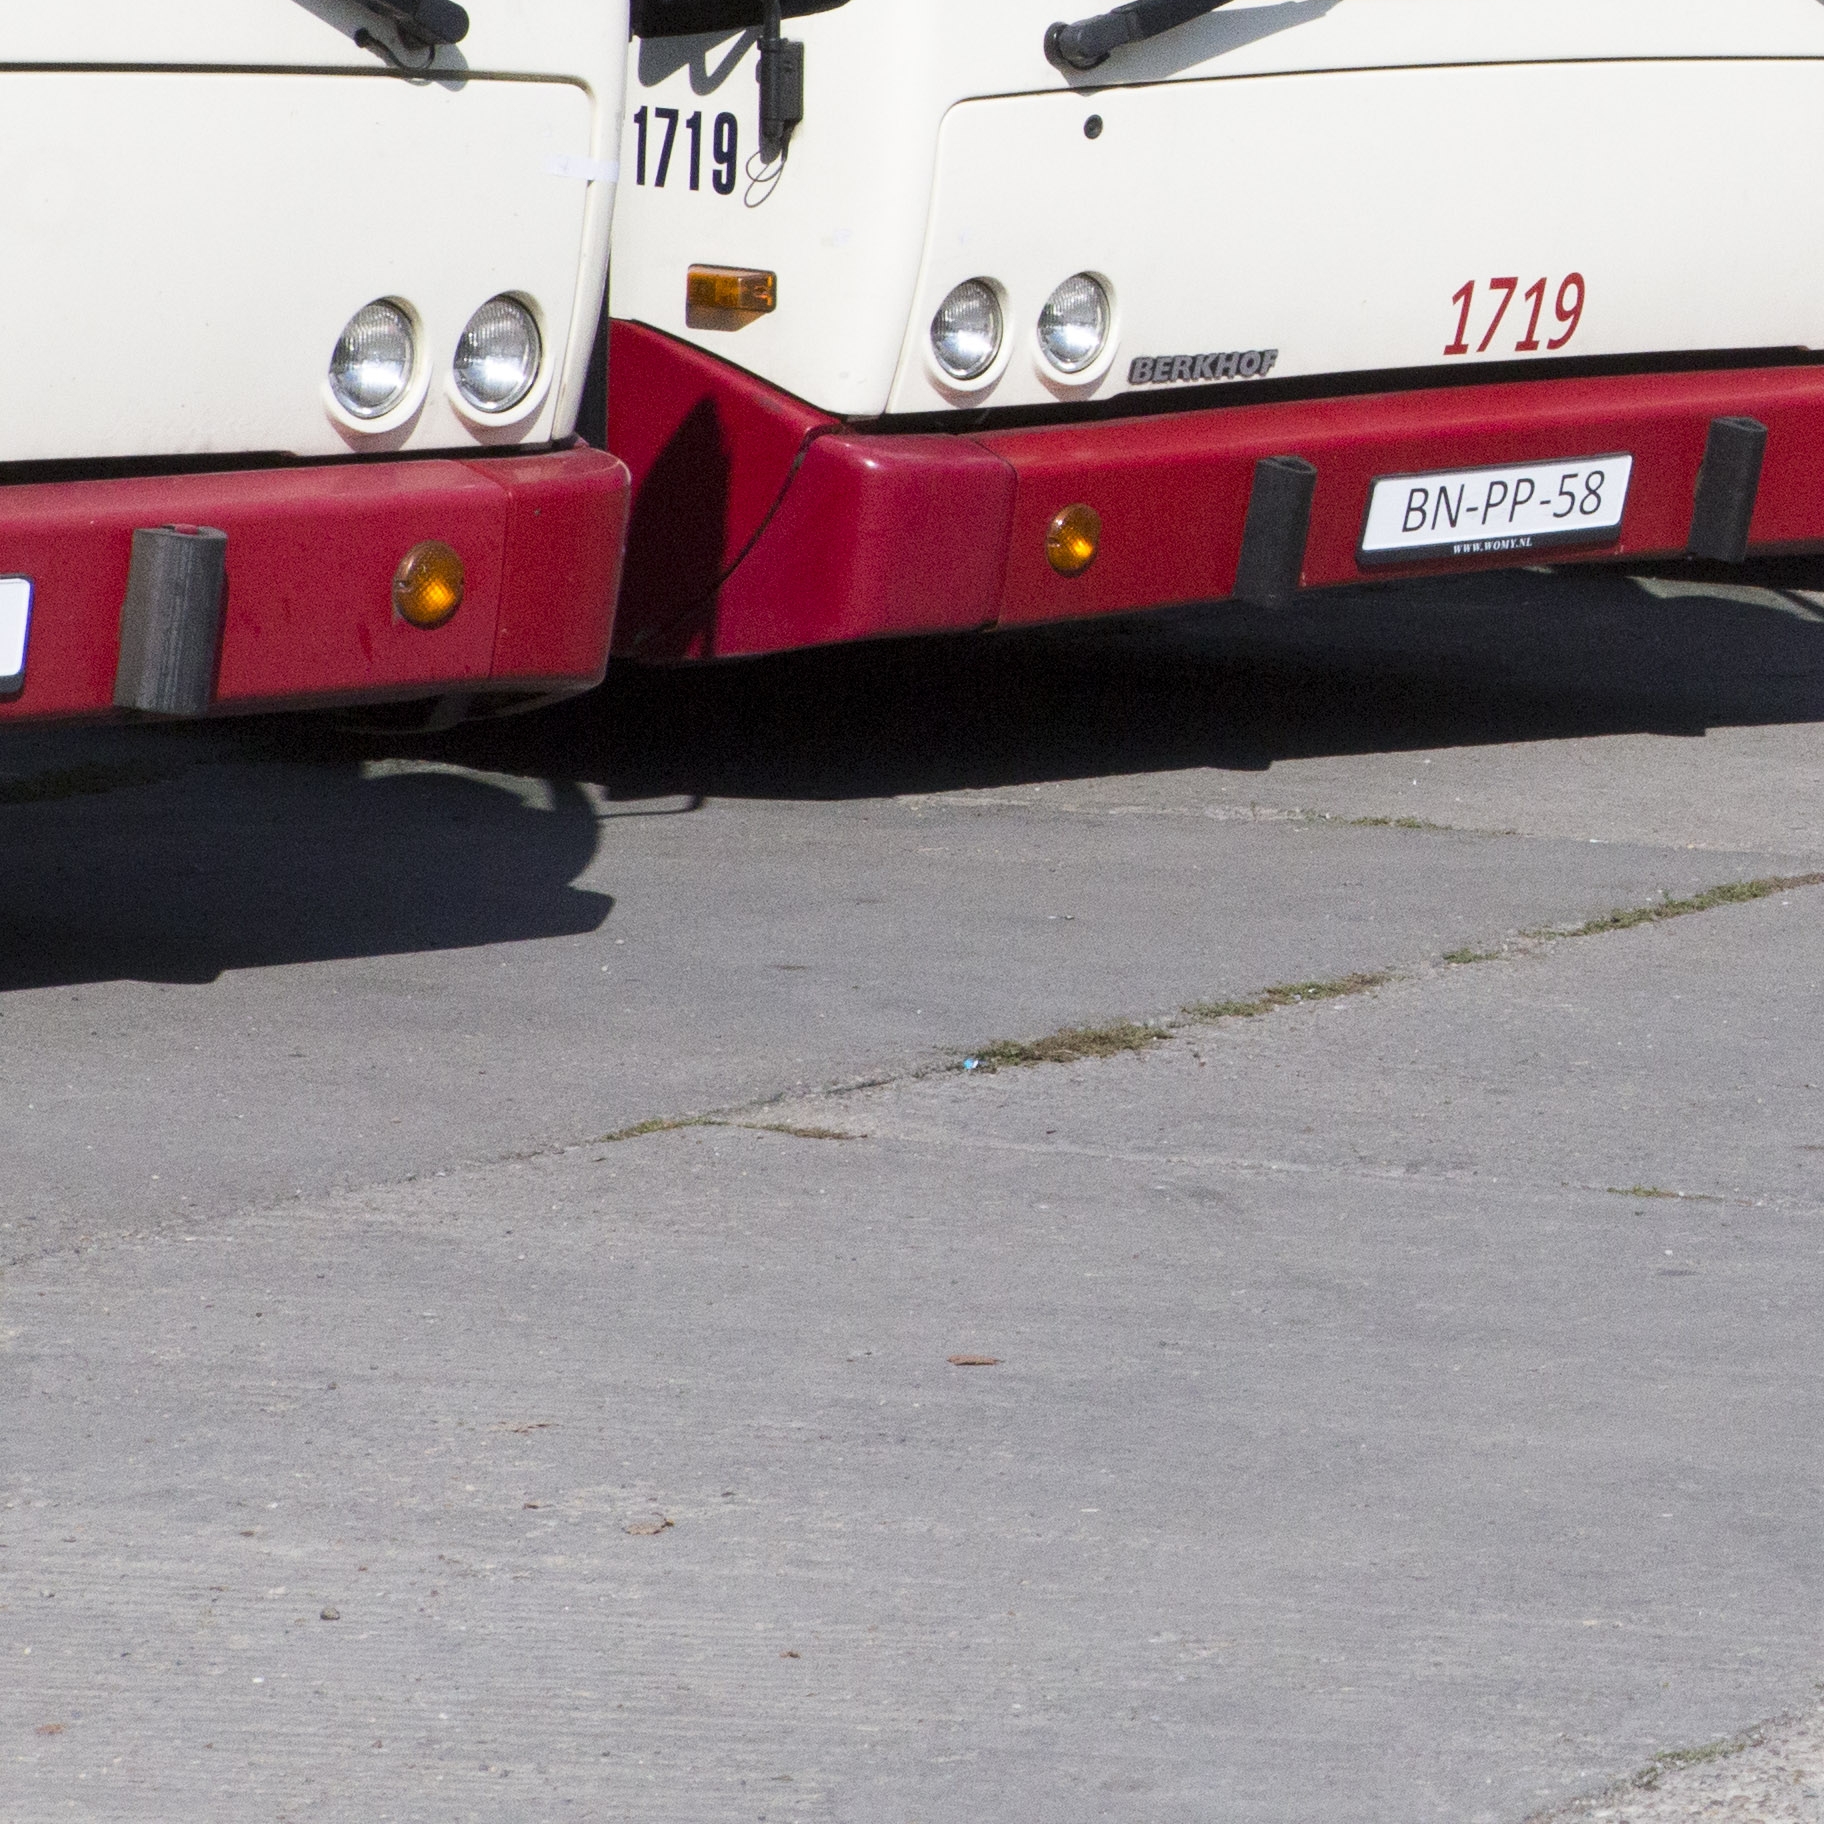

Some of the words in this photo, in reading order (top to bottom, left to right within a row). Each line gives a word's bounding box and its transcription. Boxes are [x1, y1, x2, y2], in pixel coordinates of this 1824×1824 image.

[633, 105, 738, 196] 1719
[1443, 271, 1586, 356] 1719
[1128, 349, 1279, 385] BERKHOF
[1402, 470, 1605, 533] BN-PP-58
[1453, 537, 1532, 554] WWW.WOMY.NL
